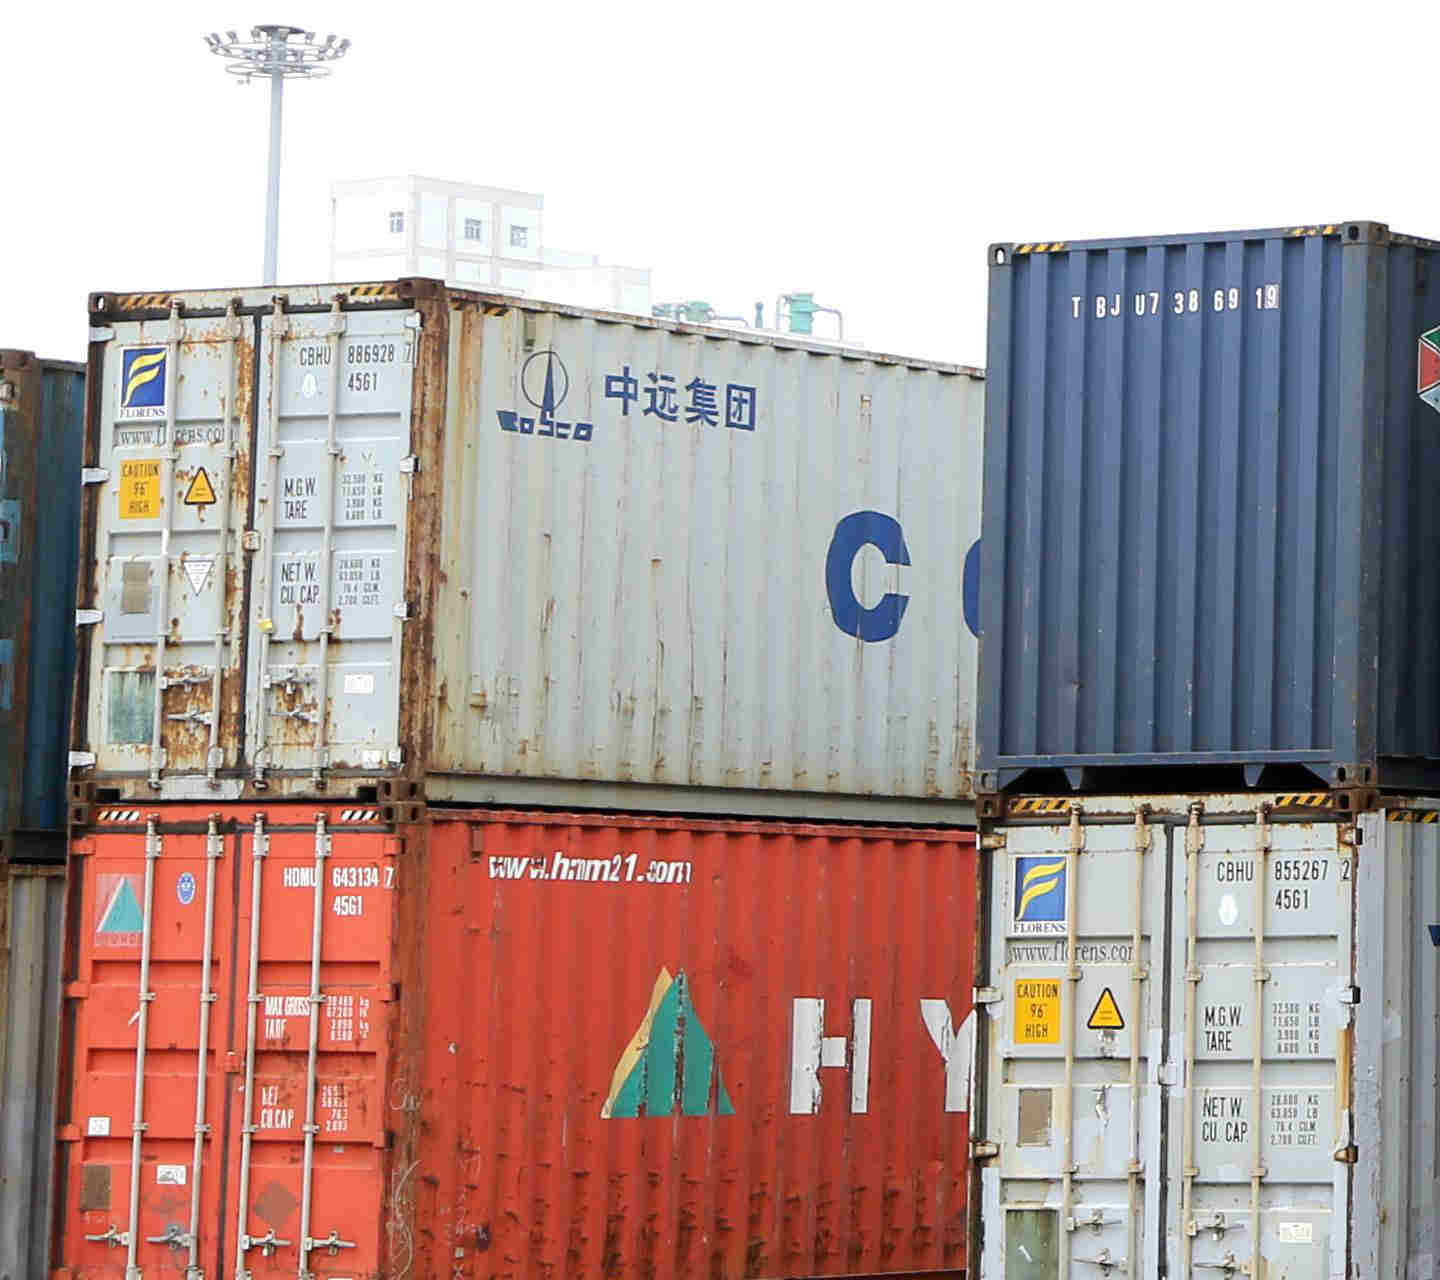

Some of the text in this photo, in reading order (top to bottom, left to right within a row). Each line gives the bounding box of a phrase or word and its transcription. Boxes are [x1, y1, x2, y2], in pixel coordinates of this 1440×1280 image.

[299, 346, 332, 366] CBHU
[347, 343, 395, 364] 886928
[347, 371, 377, 392] 45G1
[604, 366, 757, 432] 中远集团
[119, 408, 166, 418] FLORENS
[284, 499, 308, 519] TARE
[281, 563, 301, 582] NET
[332, 866, 379, 889] 643134
[1216, 859, 1351, 883] CBHU 855267 2
[332, 895, 363, 916] 45G1
[1274, 888, 1310, 910] 45G1
[1013, 922, 1067, 934] FLORENS
[1016, 983, 1059, 999] CAUTION
[1024, 1023, 1049, 1039] HIGH
[1205, 1030, 1233, 1052] TARE
[1202, 1096, 1226, 1118] NET
